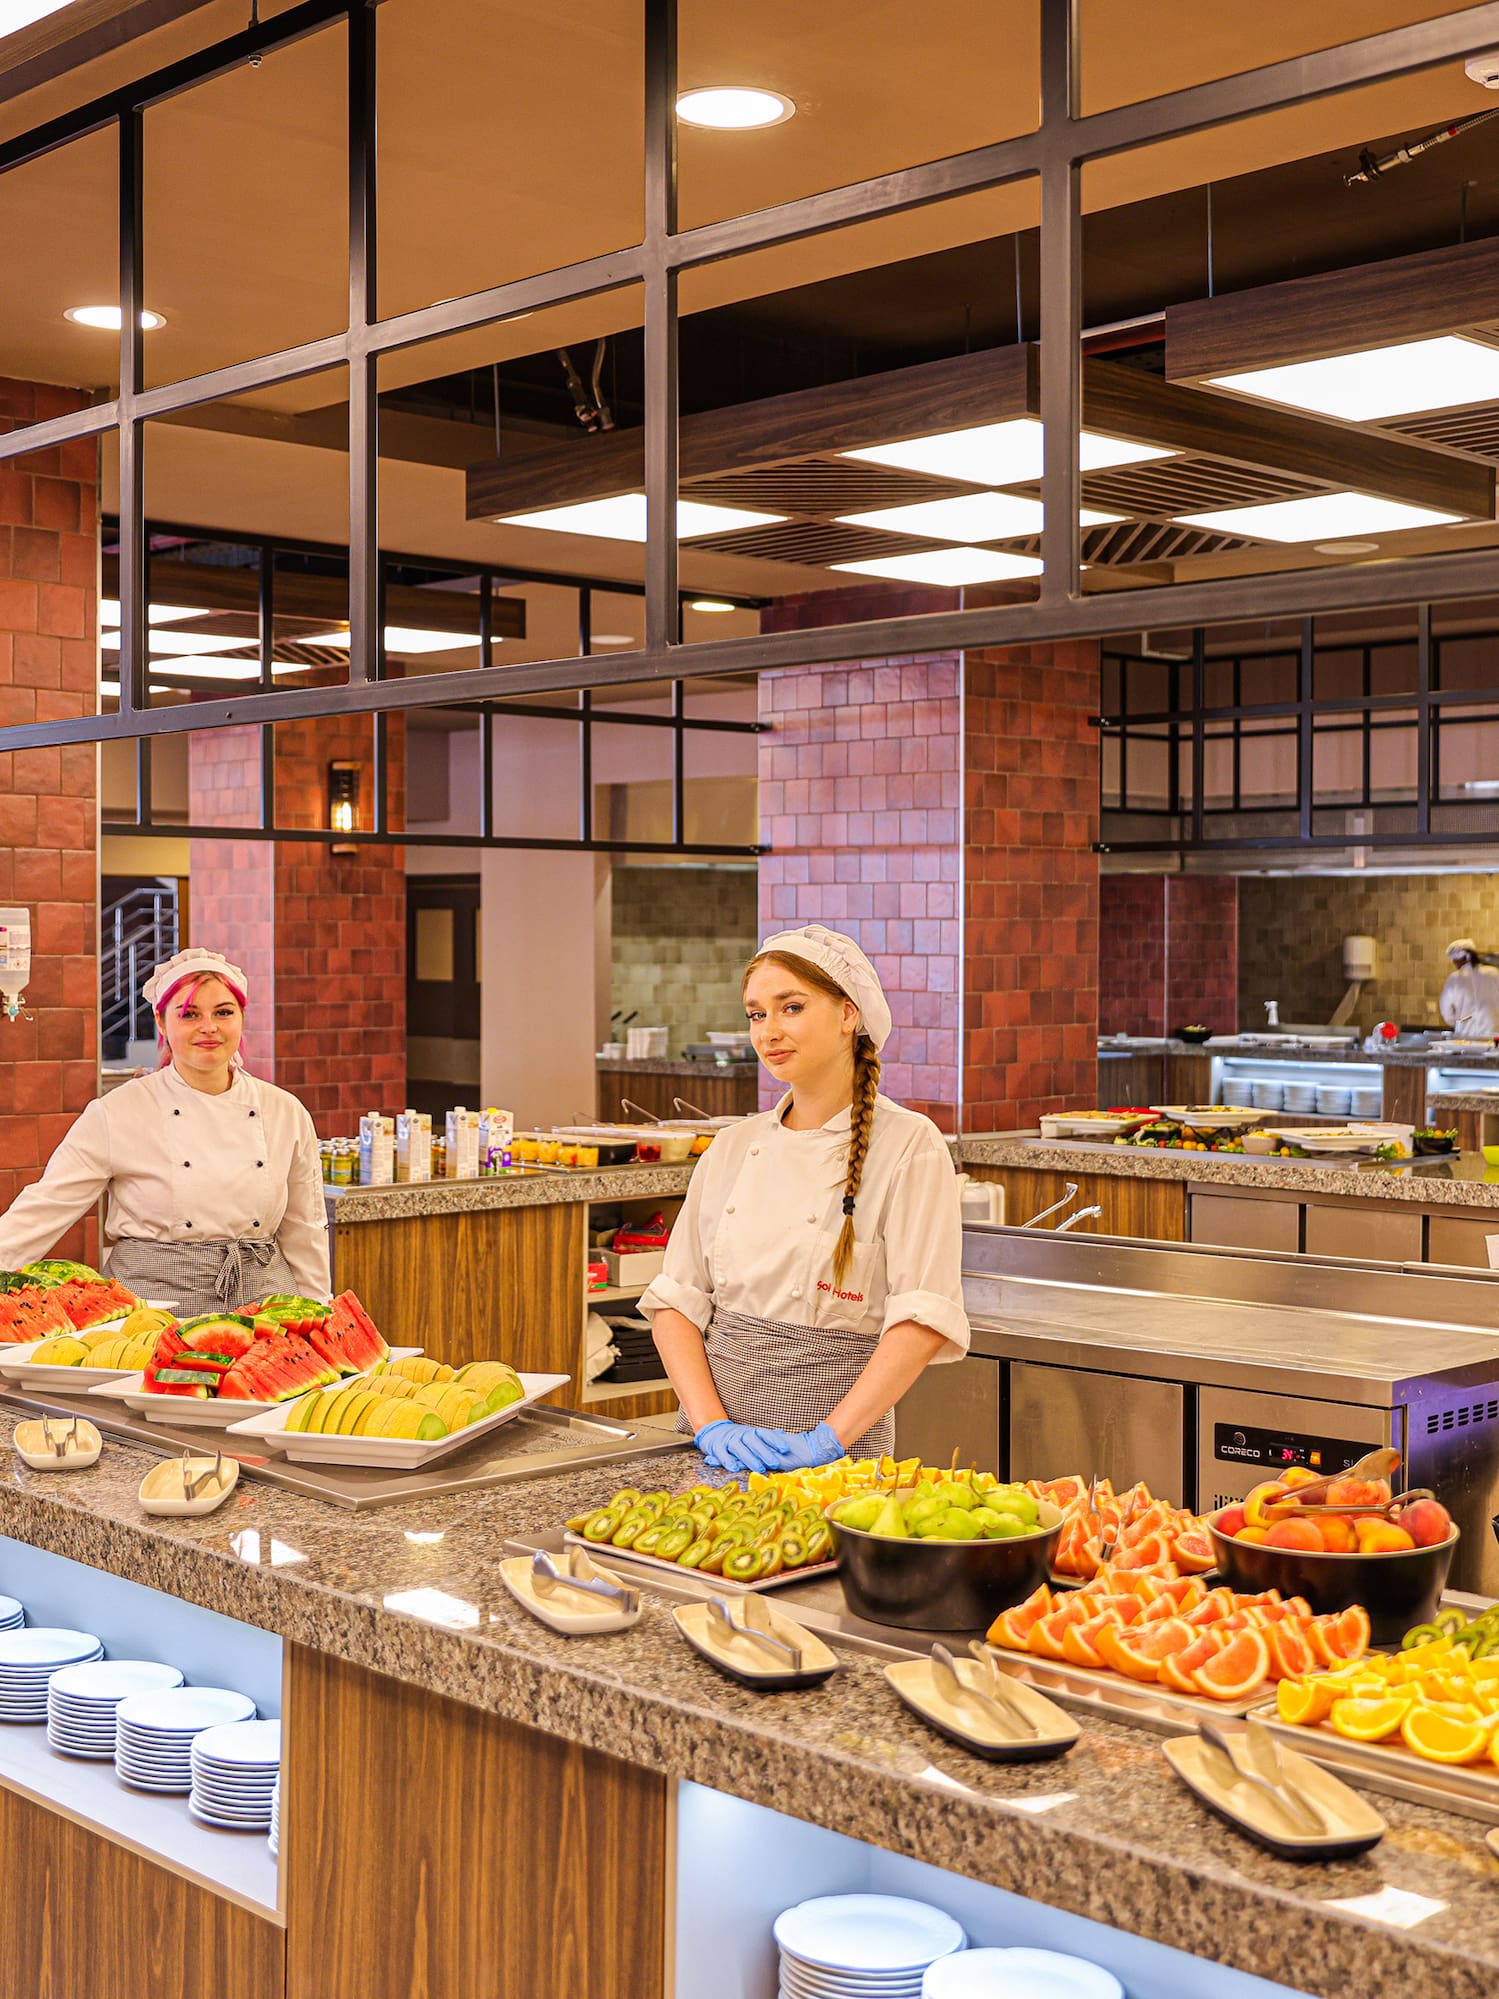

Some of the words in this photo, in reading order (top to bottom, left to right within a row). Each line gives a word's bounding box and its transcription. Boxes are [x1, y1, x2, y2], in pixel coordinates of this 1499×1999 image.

[817, 1280, 831, 1292] Sol
[832, 1287, 863, 1302] Hotels
[1220, 1445, 1260, 1458] CORECO
